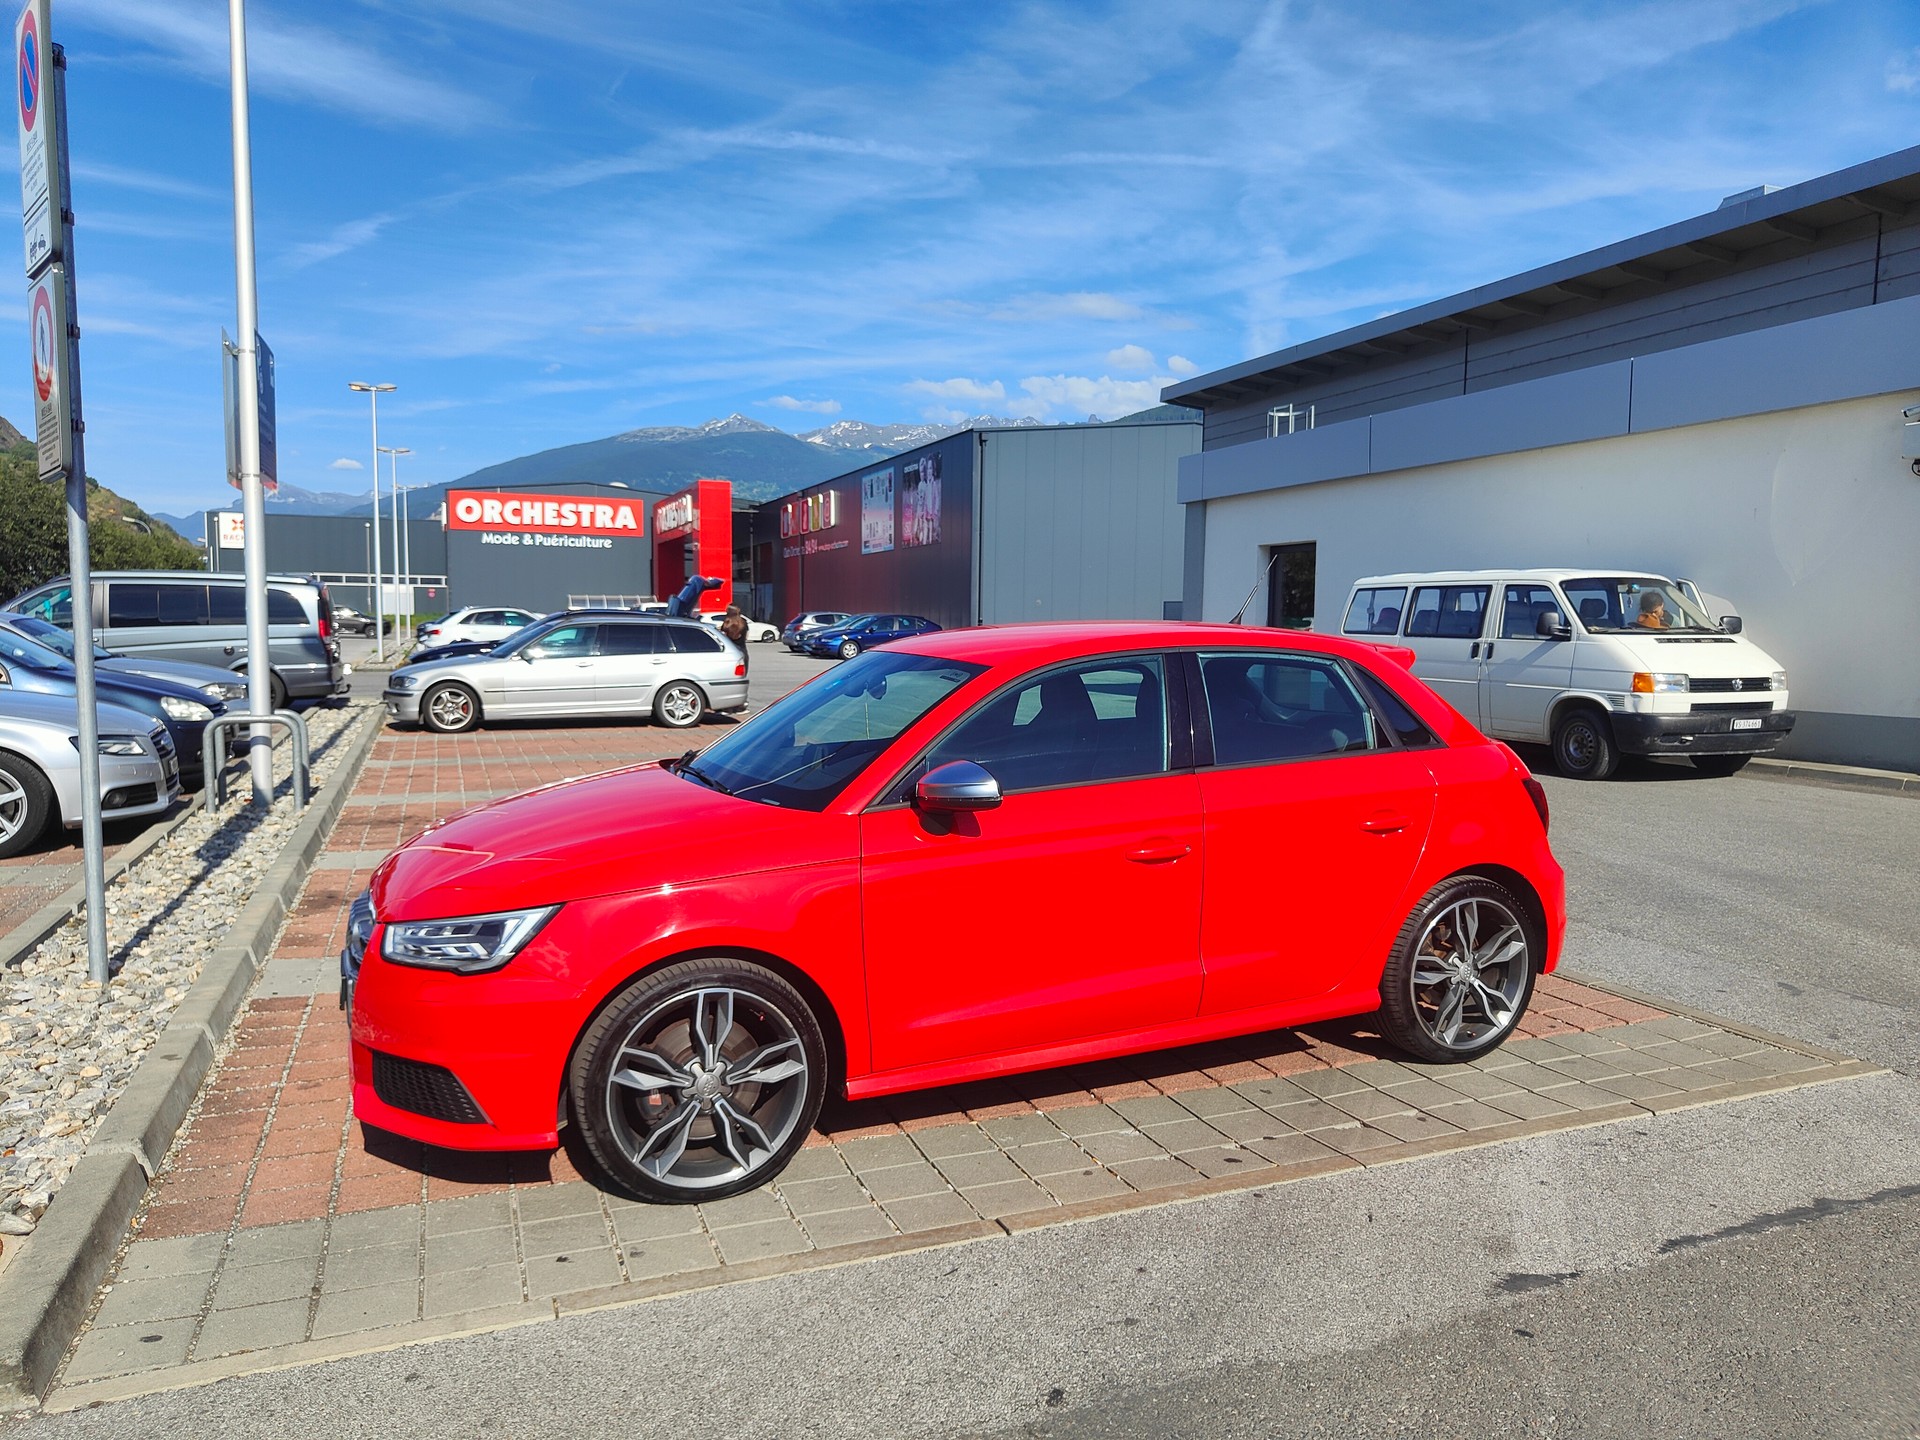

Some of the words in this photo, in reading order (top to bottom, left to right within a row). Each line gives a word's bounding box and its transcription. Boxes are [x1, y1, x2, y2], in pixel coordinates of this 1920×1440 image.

[455, 497, 637, 530] ORCHESTRA
[481, 532, 519, 545] Mode
[522, 533, 533, 546] &
[534, 533, 612, 548] Puériculture
